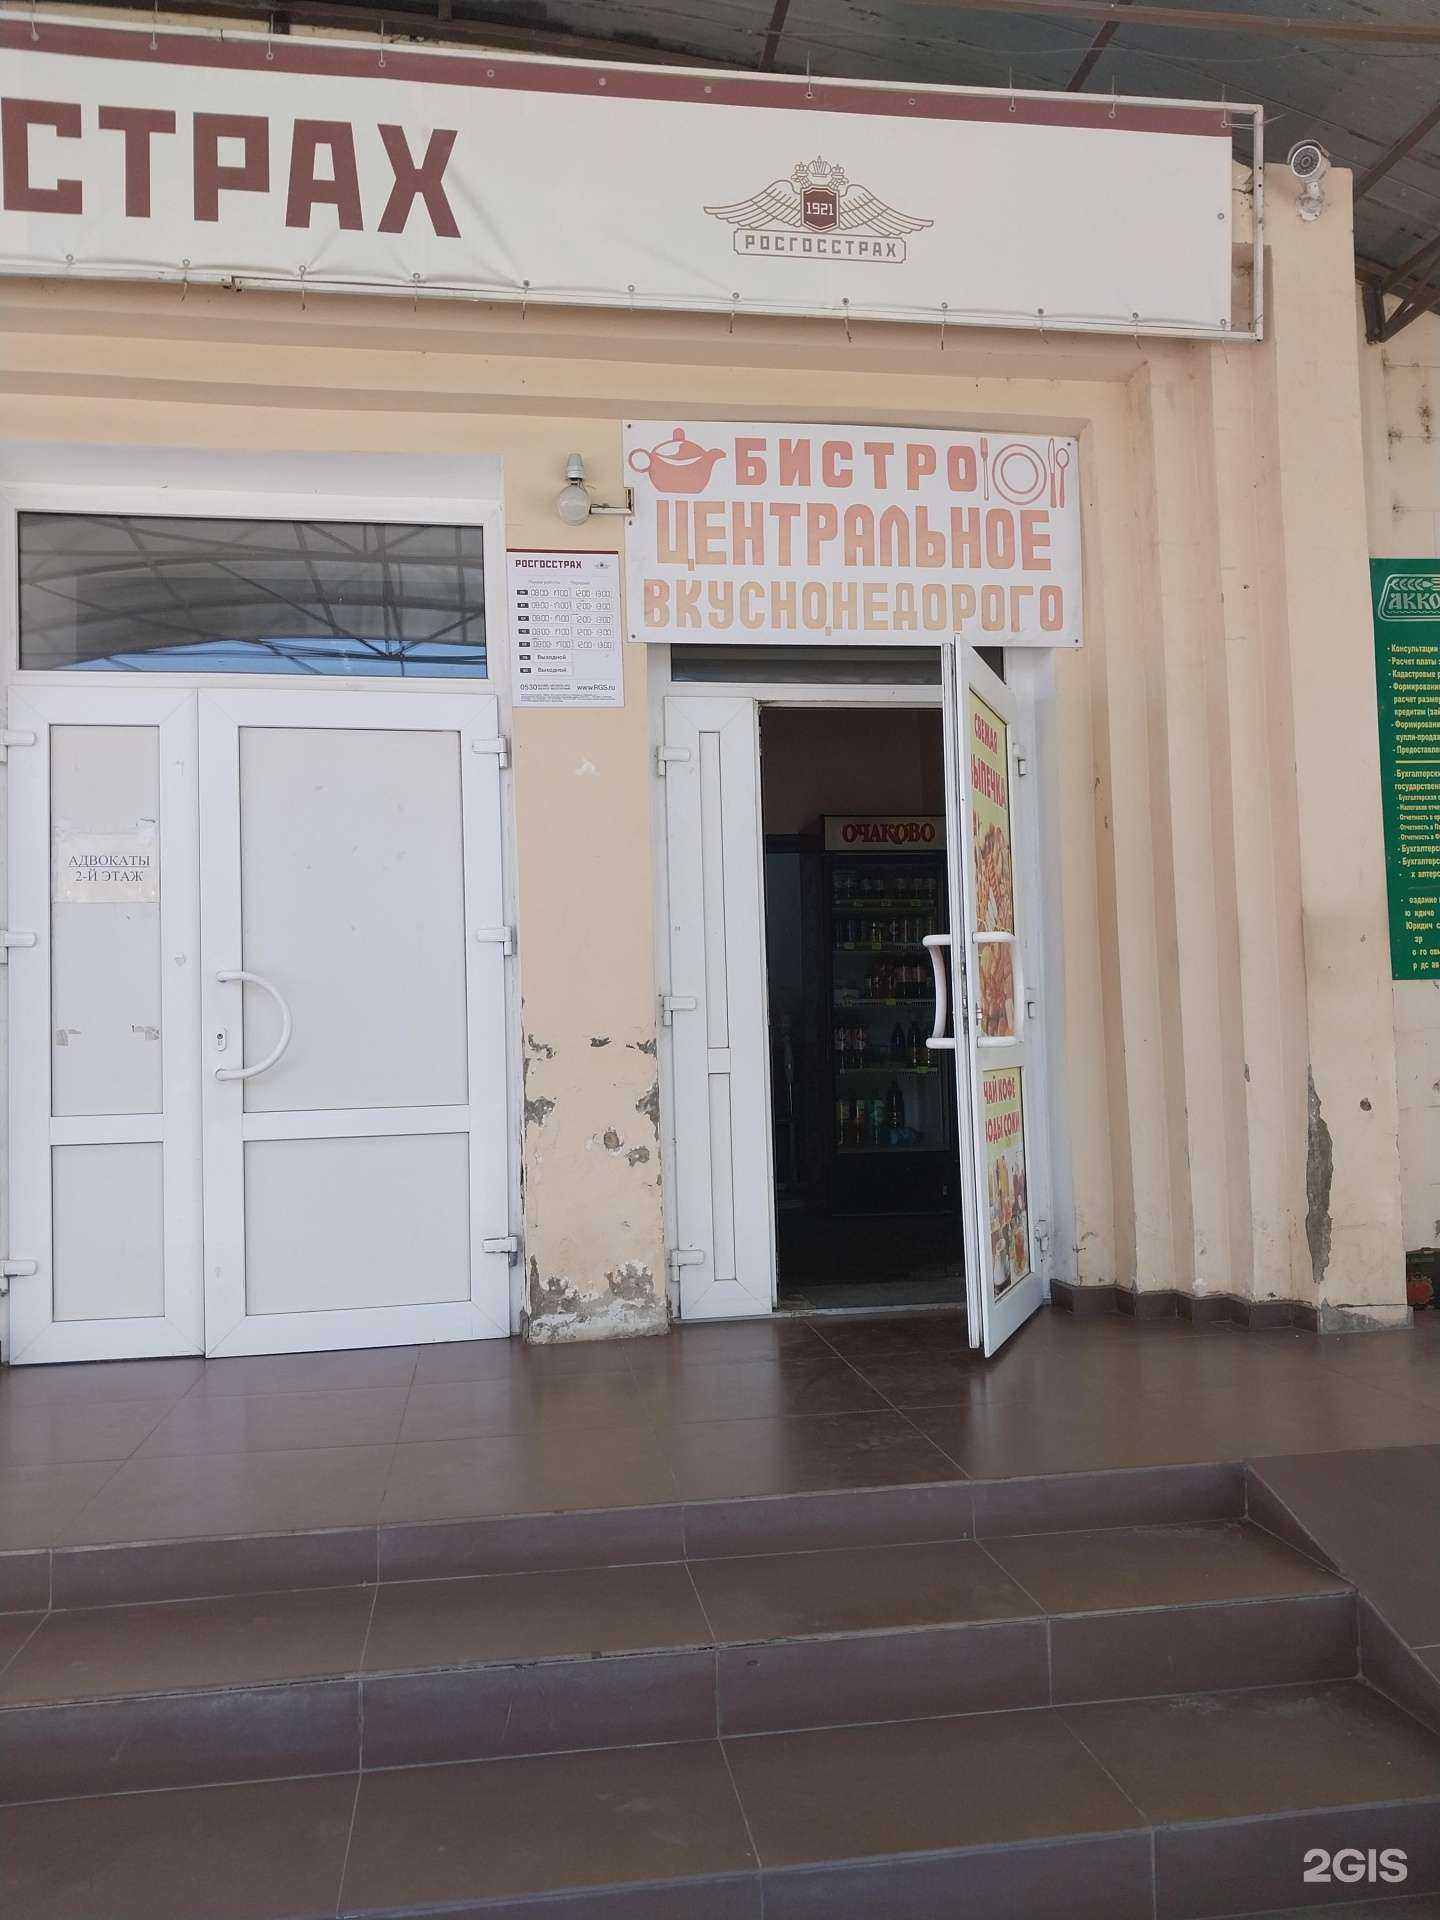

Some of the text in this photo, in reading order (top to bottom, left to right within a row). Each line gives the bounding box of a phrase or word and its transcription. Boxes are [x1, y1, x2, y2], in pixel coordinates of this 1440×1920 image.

[1, 97, 461, 239] СТРАХ
[805, 201, 834, 217] 1921
[745, 234, 897, 258] РОСГОССТРАХ
[735, 437, 977, 493] БИСТРО
[656, 500, 1052, 572] ЦЕНТРАЛЬНОЕ
[515, 559, 582, 569] РОСГОССТРАХ
[842, 823, 936, 845] ОЧАКОВО
[68, 855, 151, 867] АДВОКАТЫ
[75, 868, 145, 882] 2-Й ЭТАЖ
